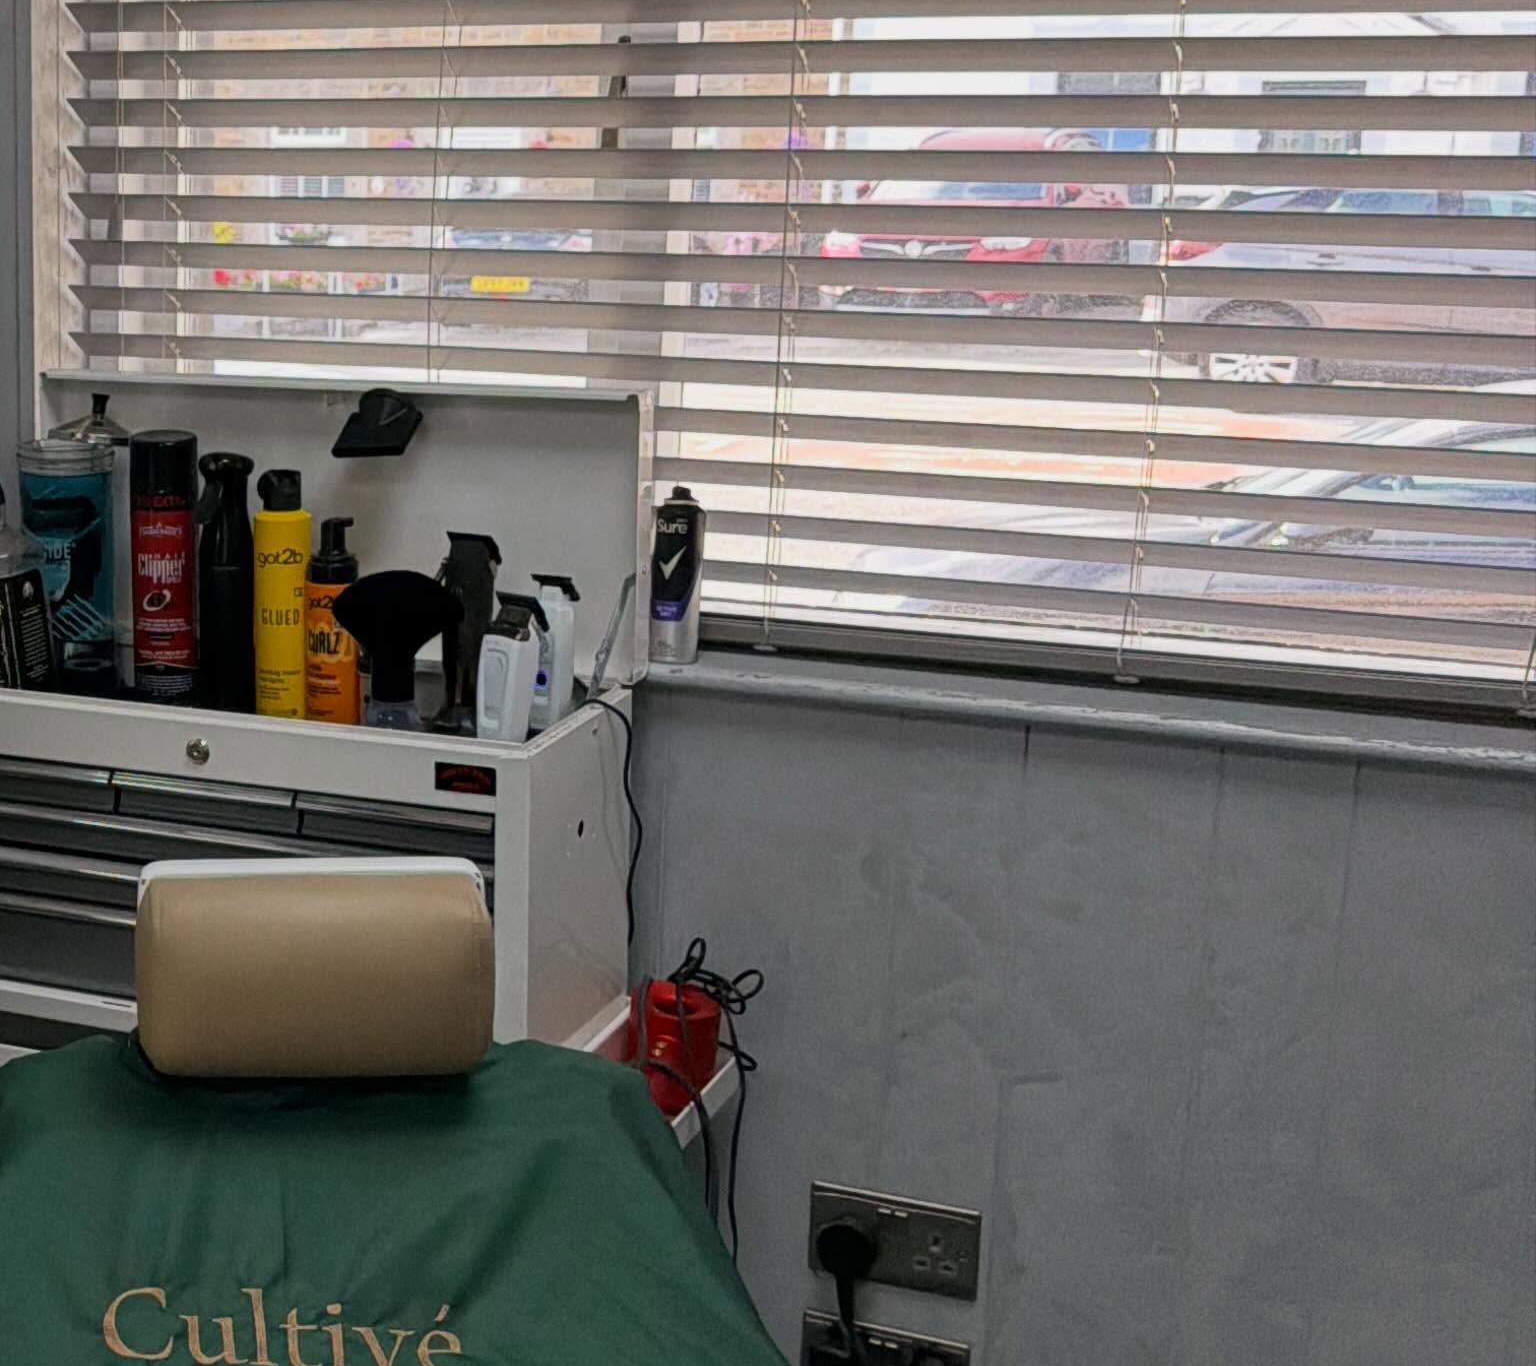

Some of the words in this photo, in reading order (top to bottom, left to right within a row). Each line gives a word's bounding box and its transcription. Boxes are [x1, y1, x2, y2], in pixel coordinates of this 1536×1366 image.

[656, 518, 688, 535] Sure
[257, 547, 304, 568] got2b
[308, 595, 334, 610] got2
[261, 608, 301, 626] GLUED
